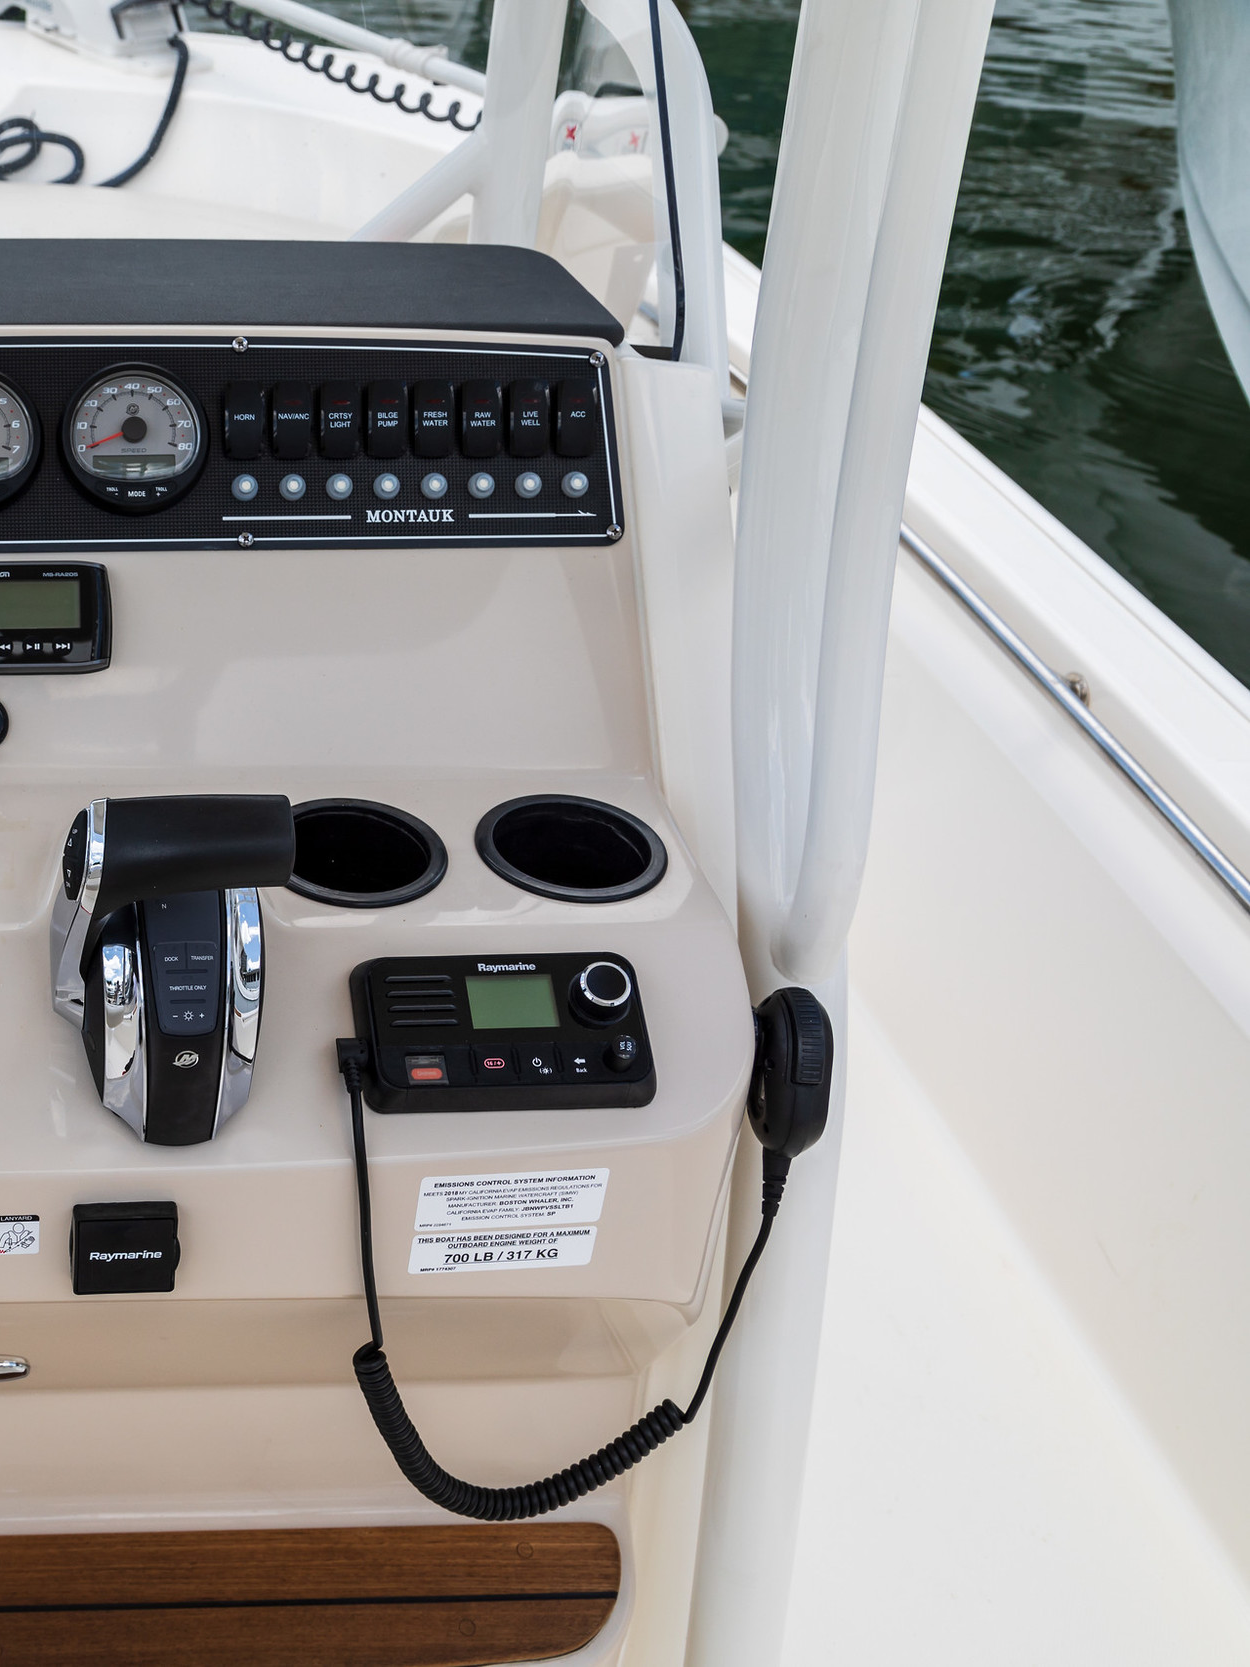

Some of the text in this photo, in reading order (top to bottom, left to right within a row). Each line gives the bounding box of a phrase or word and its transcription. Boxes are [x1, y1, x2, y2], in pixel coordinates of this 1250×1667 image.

[147, 386, 163, 394] 50
[233, 413, 256, 421] HORN
[277, 412, 310, 421] NAV/ANC
[328, 412, 353, 420] CRTSY
[377, 411, 399, 419] BILGE
[474, 411, 492, 419] RAW
[12, 420, 21, 428] 6
[77, 421, 88, 430] 10
[177, 420, 192, 428] 70
[329, 421, 351, 429] LIGHT
[377, 420, 399, 428] PUMP
[422, 419, 449, 427] WATER
[521, 419, 541, 427] WELL
[12, 445, 21, 454] 7
[77, 444, 86, 452] 0
[178, 442, 193, 450] 80
[365, 509, 455, 523] MONTAUK
[477, 961, 537, 973] Raymarine
[434, 1174, 596, 1189] EMISSIONS CONTROL SYSTEM INFORMATION
[494, 1232, 531, 1240] DESIGNED
[556, 1229, 591, 1237] MAXIMUM
[447, 1241, 489, 1249] OUTBOARD
[89, 1249, 163, 1262] Raymarine
[444, 1248, 559, 1264] 700 LB / 317 KG
